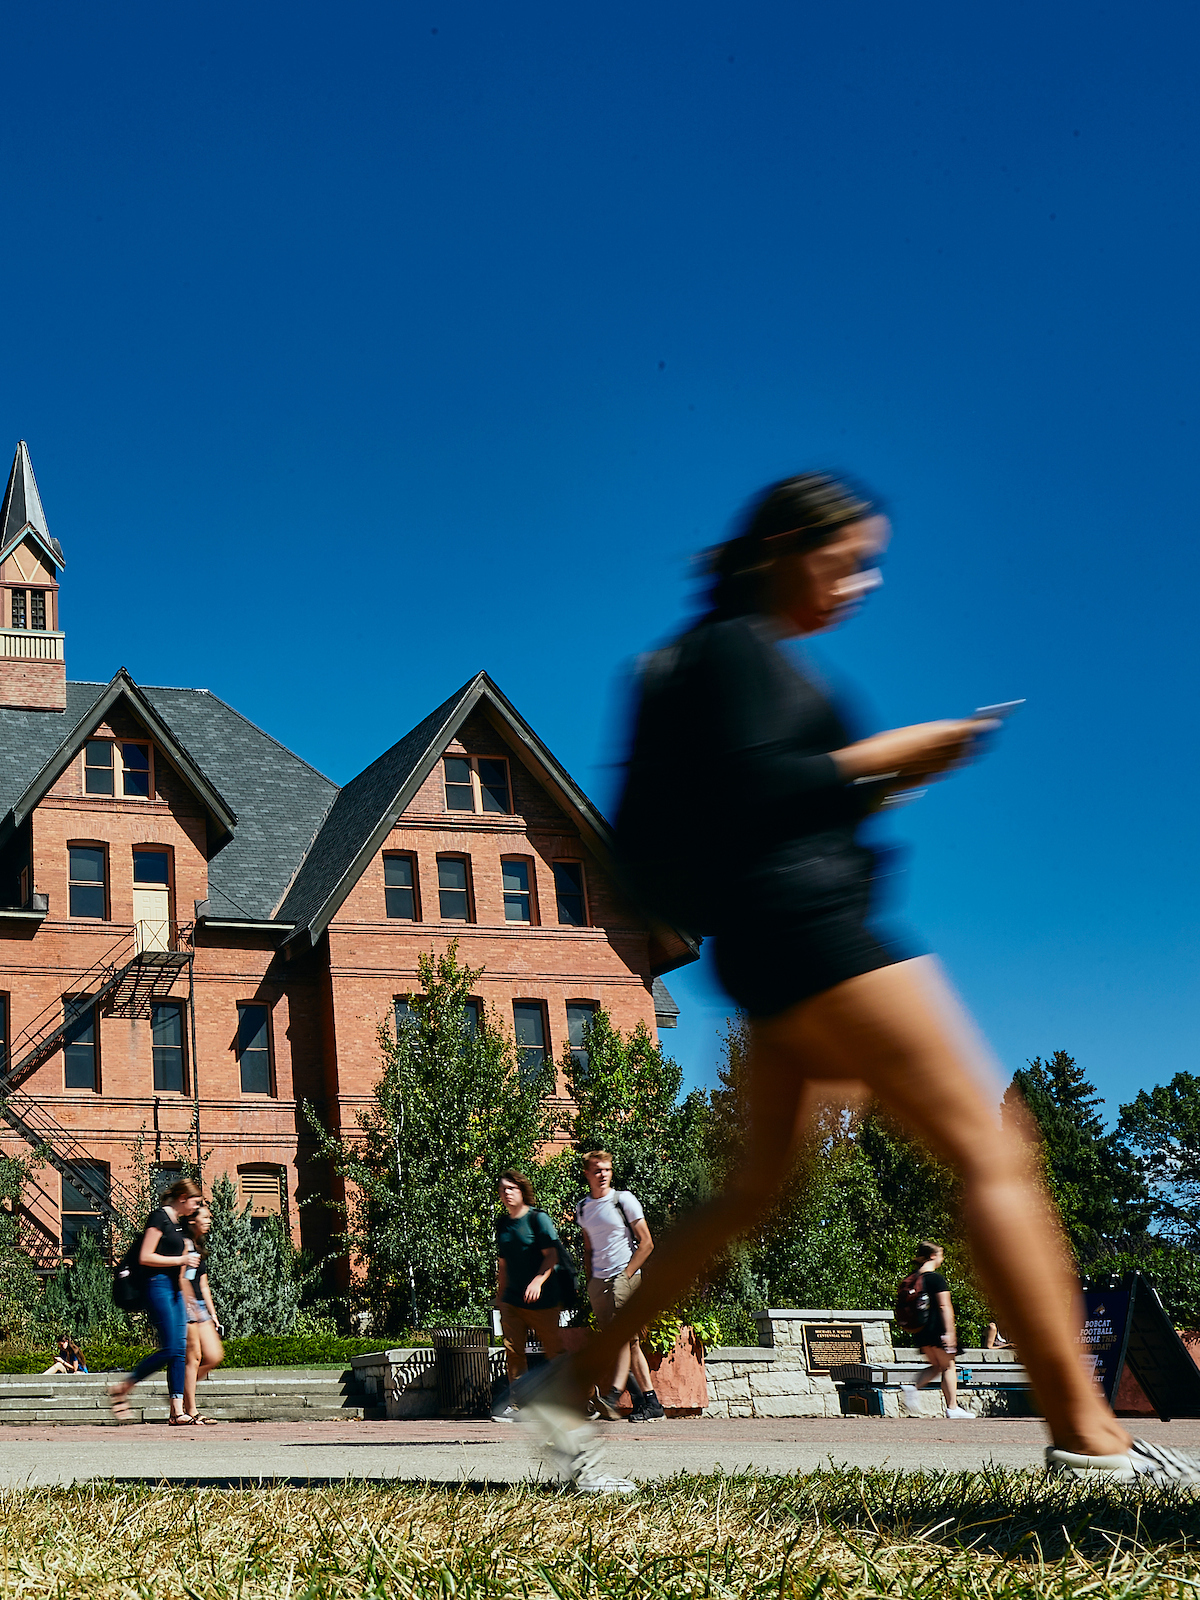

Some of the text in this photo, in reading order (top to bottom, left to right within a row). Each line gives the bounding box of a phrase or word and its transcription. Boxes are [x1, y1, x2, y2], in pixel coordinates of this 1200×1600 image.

[1084, 1320, 1112, 1328] BOBCAT
[1080, 1328, 1114, 1336] FOOTBALL
[1080, 1336, 1100, 1344] HOME
